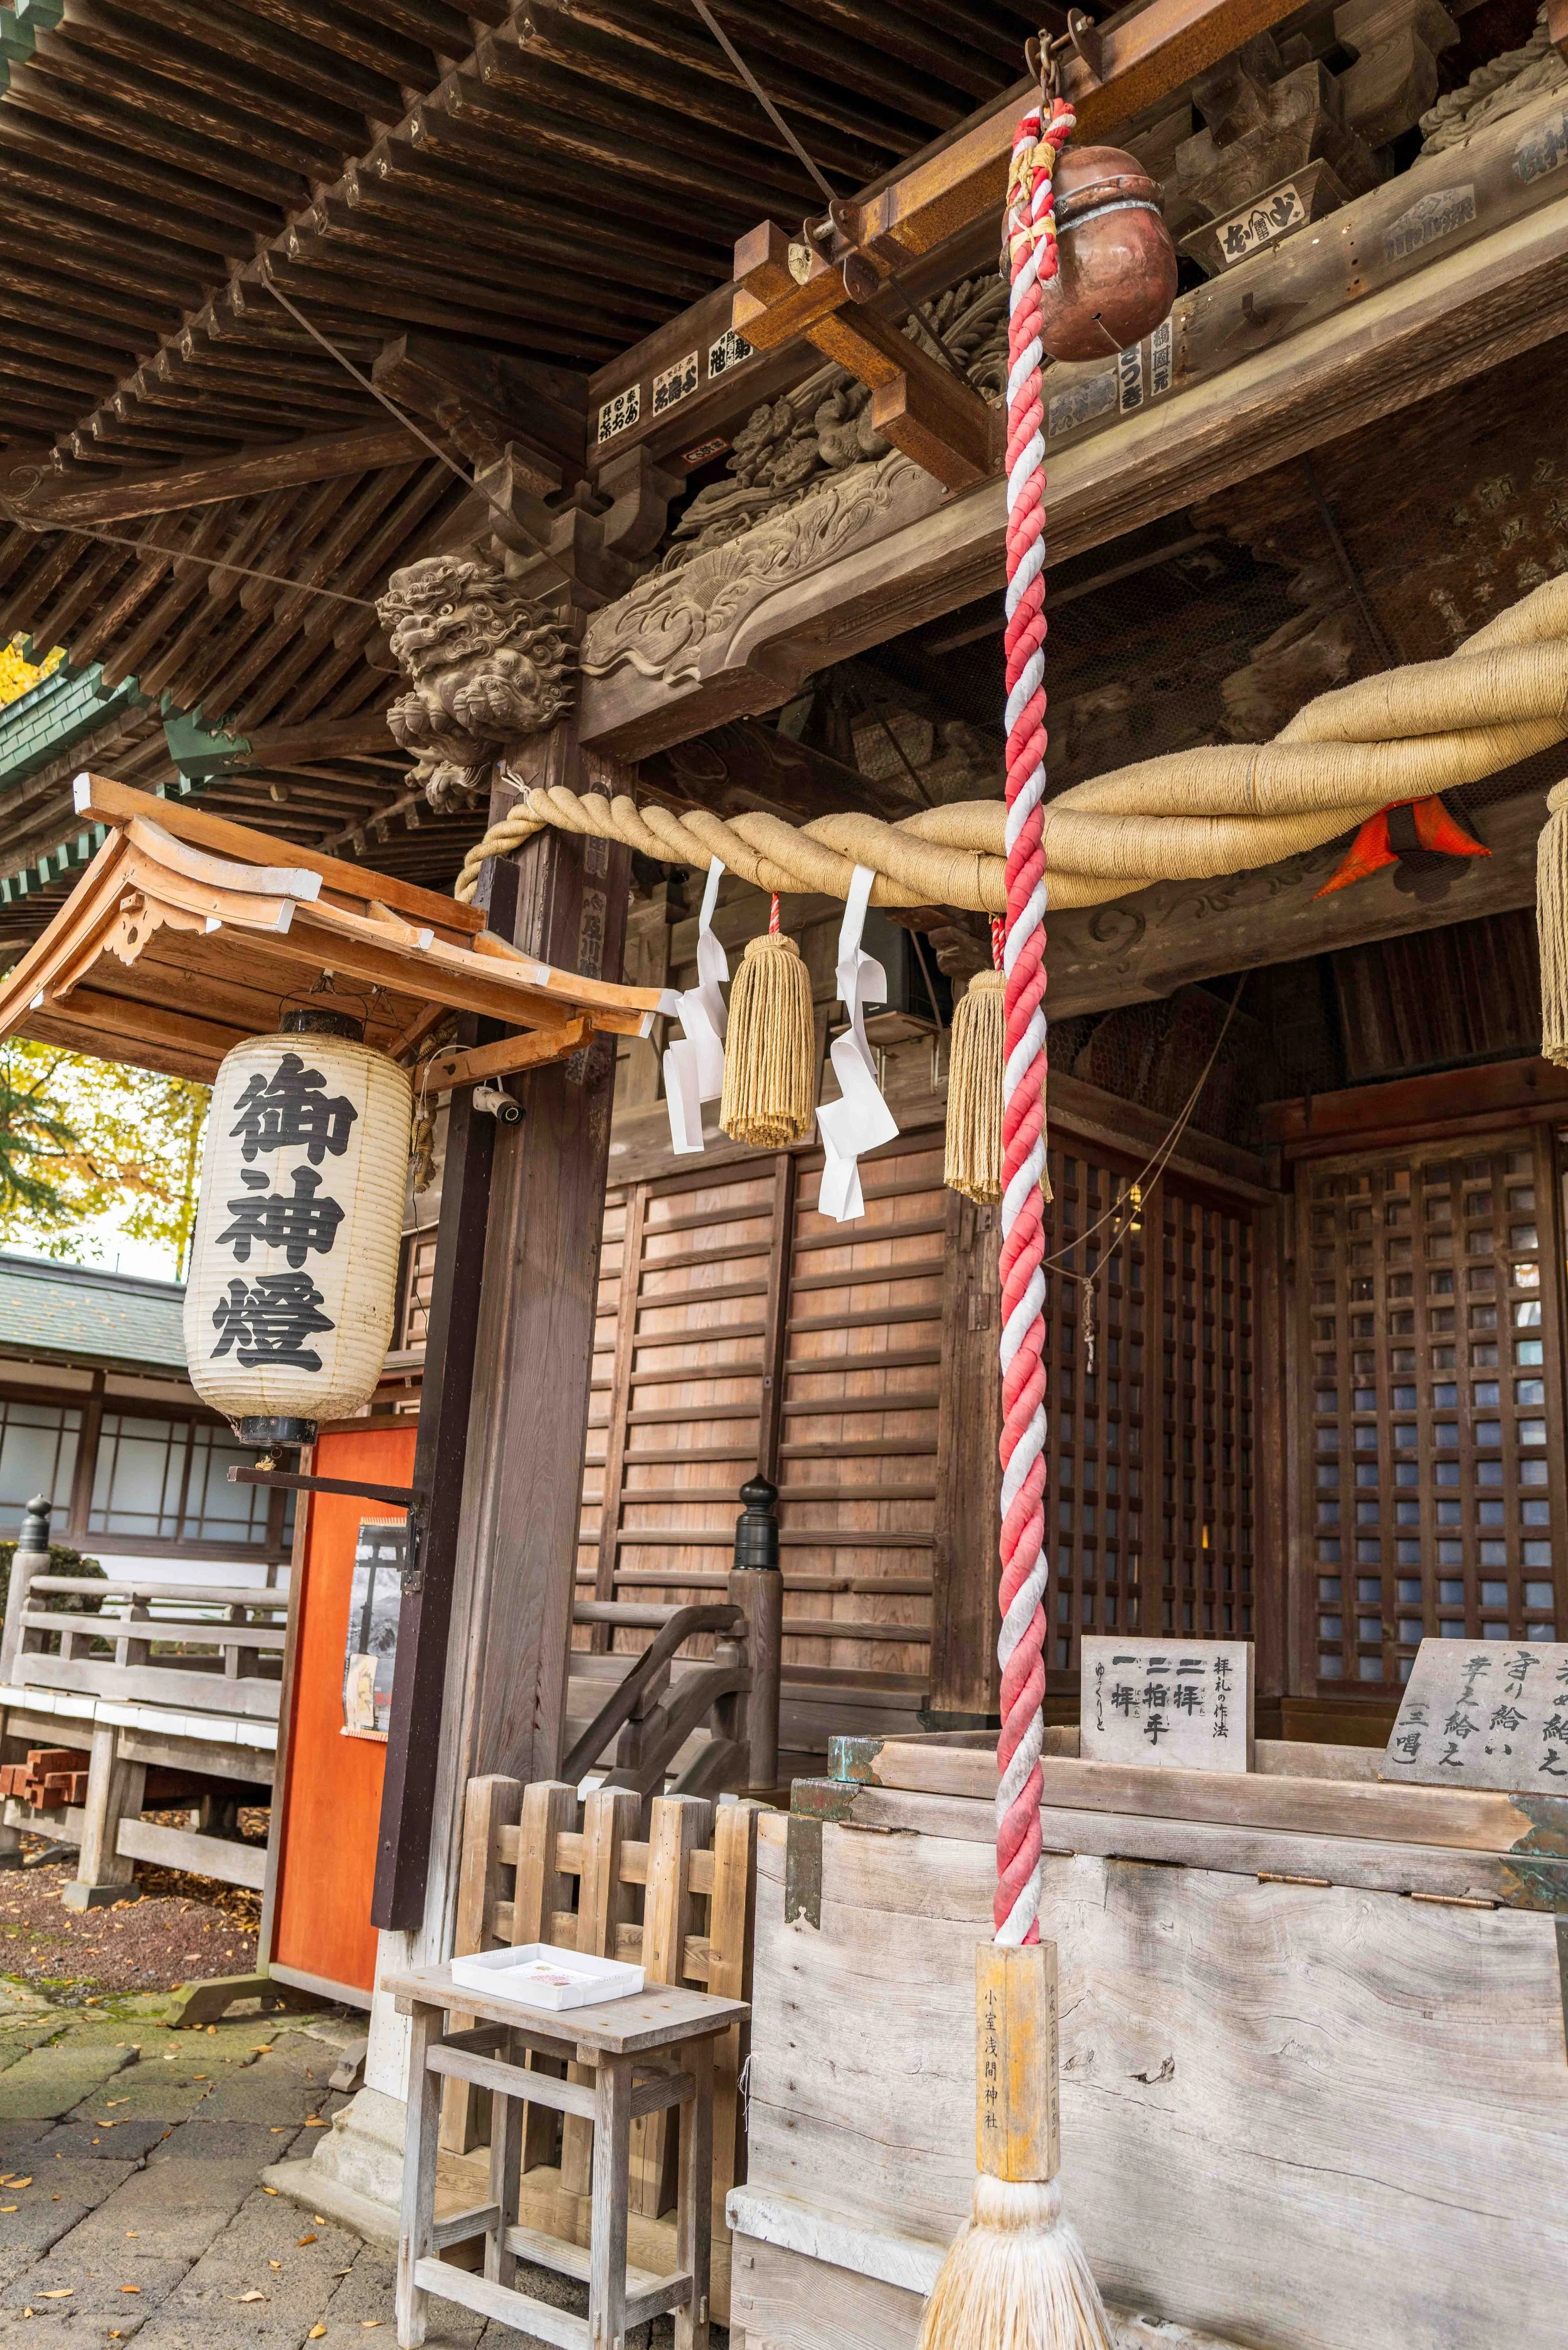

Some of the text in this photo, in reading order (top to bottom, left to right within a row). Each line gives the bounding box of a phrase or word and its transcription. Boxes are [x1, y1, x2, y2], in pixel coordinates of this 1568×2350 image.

[210, 1053, 358, 1372] 御神燈
[1096, 1662, 1104, 1731] ゆっくりと
[1111, 1656, 1140, 1716] 一拝
[1143, 1657, 1171, 1745] 二拍手
[1173, 1659, 1205, 1716] 二拝
[1213, 1657, 1232, 1738] 拝礼の作法
[1485, 1651, 1540, 1755] 守り給い
[985, 1989, 998, 2129] 小室浅間神社
[1048, 1985, 1057, 2139] 平成二十七年十一月吉日
